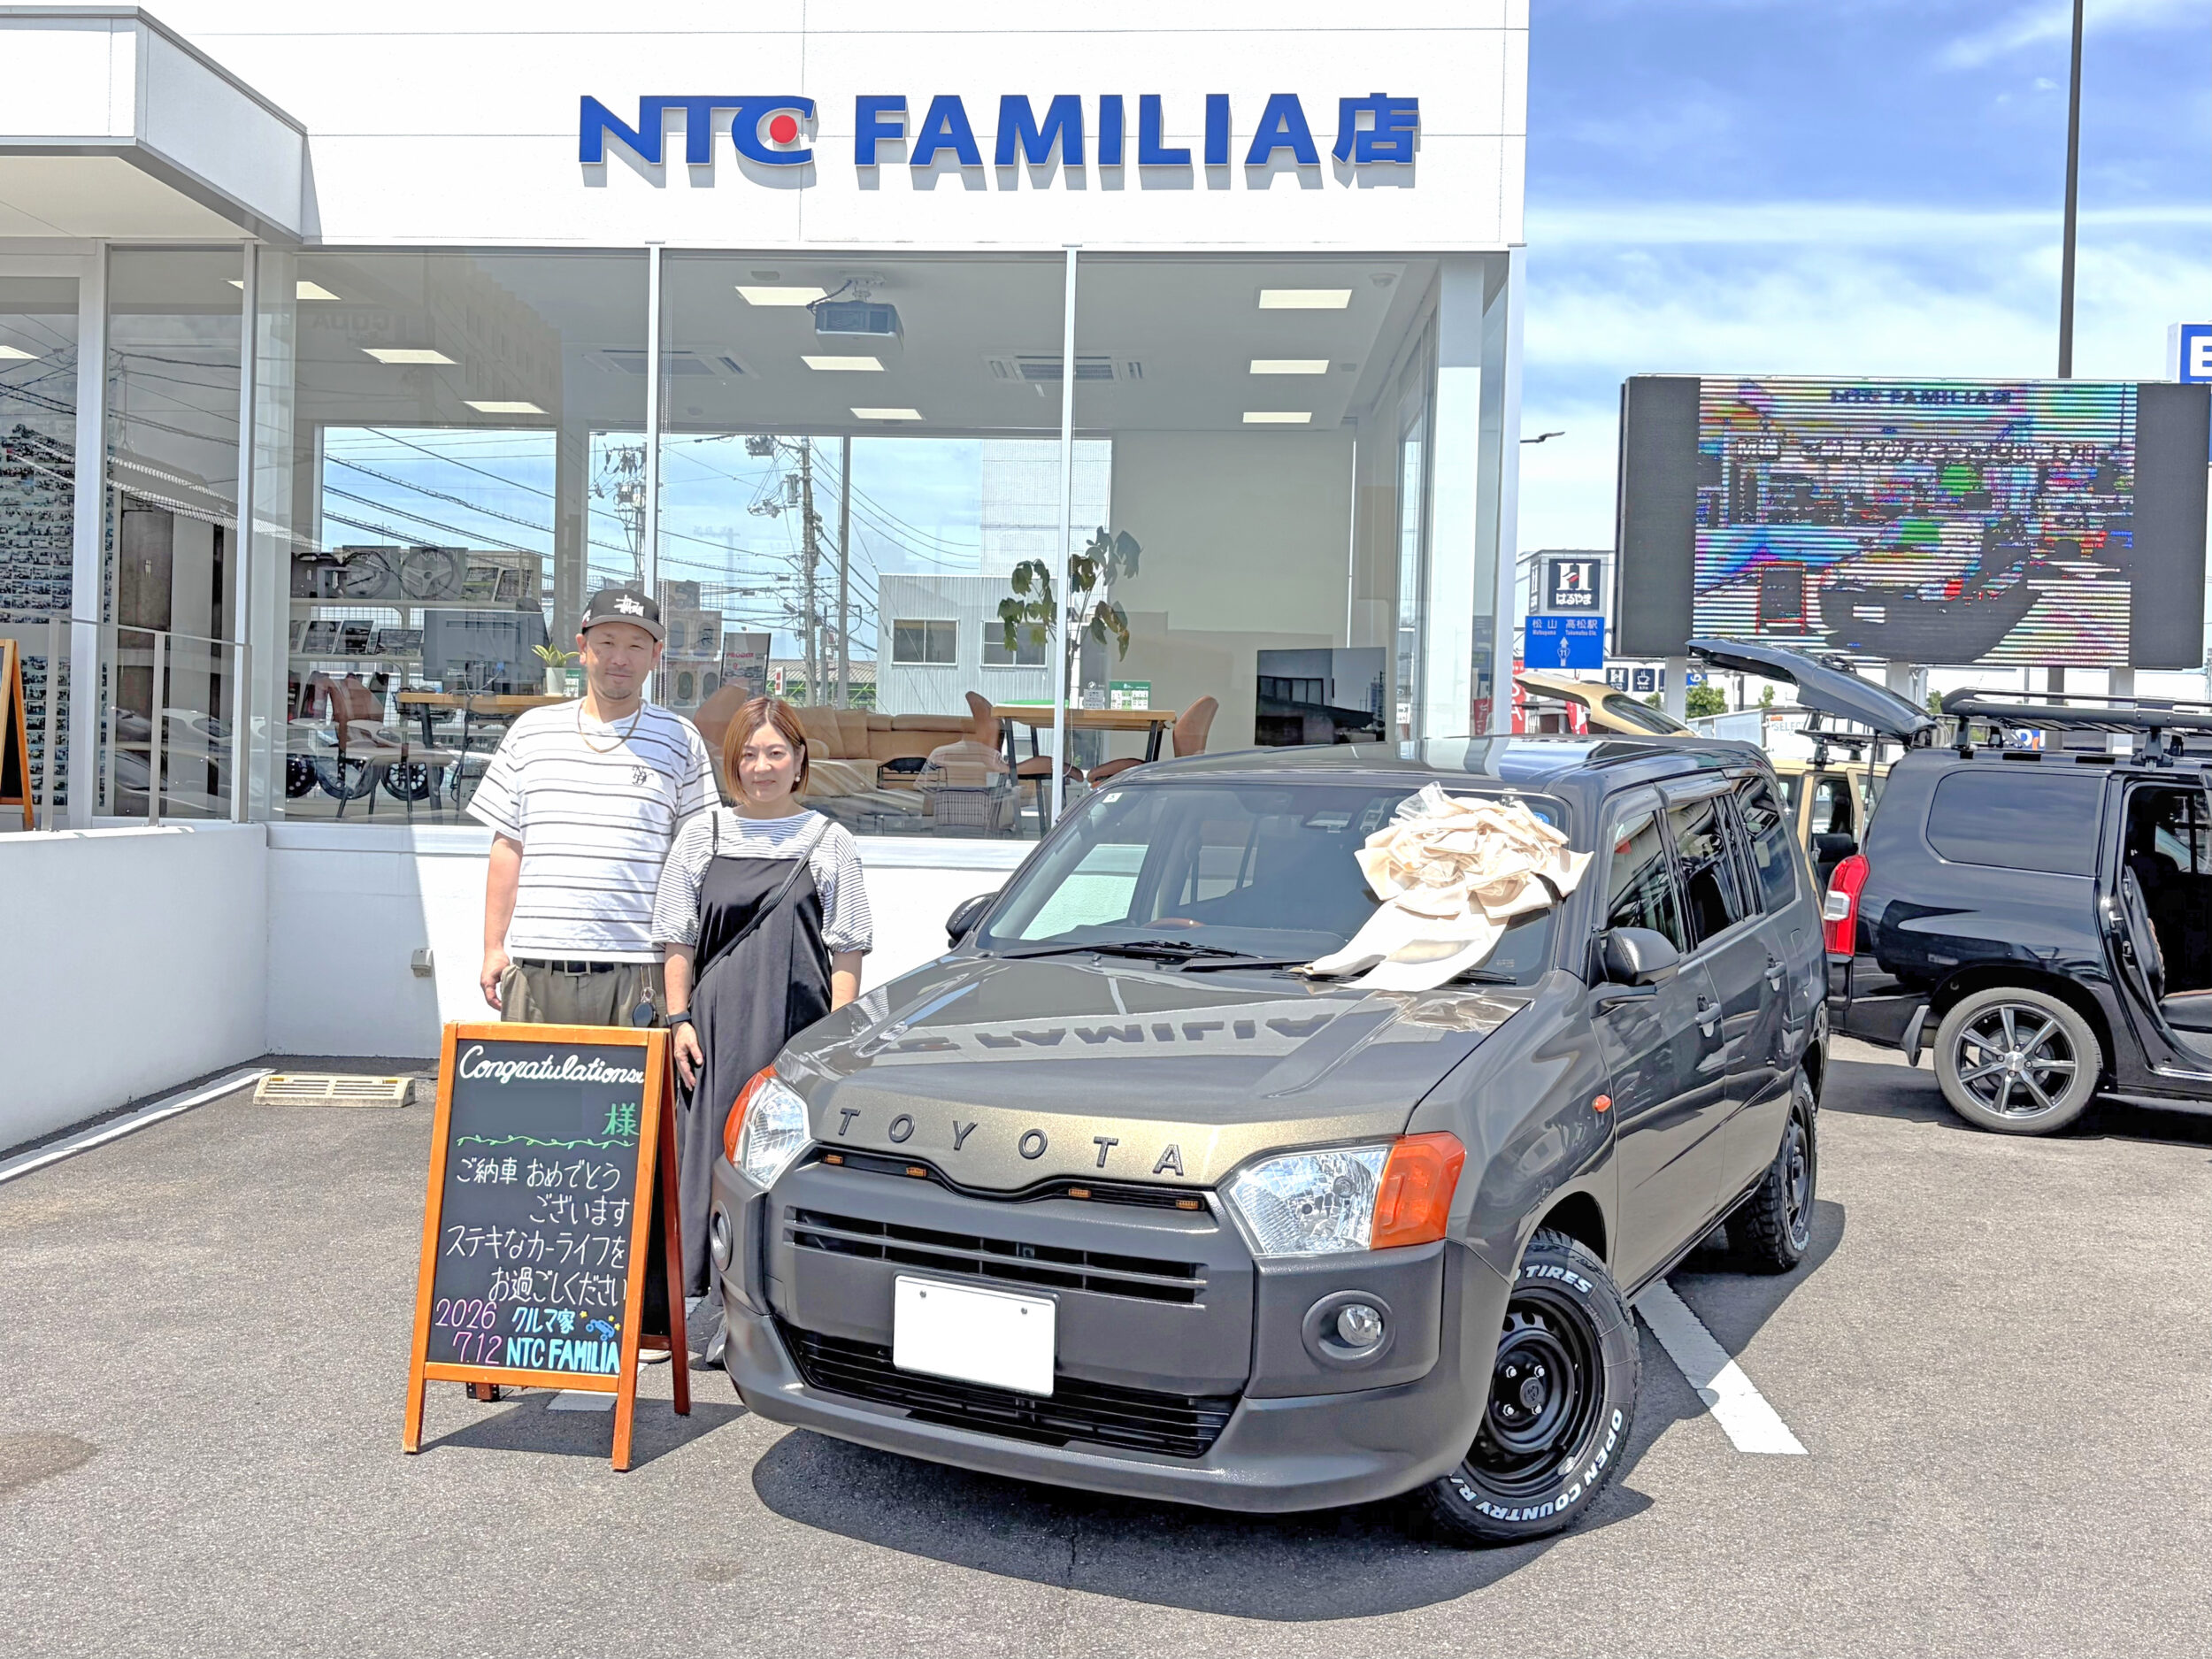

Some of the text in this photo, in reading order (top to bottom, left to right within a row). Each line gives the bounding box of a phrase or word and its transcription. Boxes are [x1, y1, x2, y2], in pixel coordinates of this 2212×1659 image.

[580, 95, 815, 165] NTC
[1555, 593, 1593, 605] はるやま
[460, 1045, 645, 1084] Congratulations
[602, 1102, 641, 1137] 様
[838, 1108, 1184, 1176] TOYOTA
[457, 1156, 620, 1192] ご納車 おめでとう
[529, 1194, 630, 1226] ございます
[446, 1225, 626, 1268] ステキなカーライフを
[488, 1267, 626, 1307] お過ごしください
[1525, 1264, 1594, 1294] TIRES
[435, 1298, 497, 1329] 2026
[511, 1307, 575, 1334] クルマ家
[452, 1331, 503, 1364] 7.12
[505, 1337, 620, 1373] NTC FAMILIA
[1584, 1408, 1623, 1486] OPEN
[1476, 1483, 1582, 1521] COUNTRY
